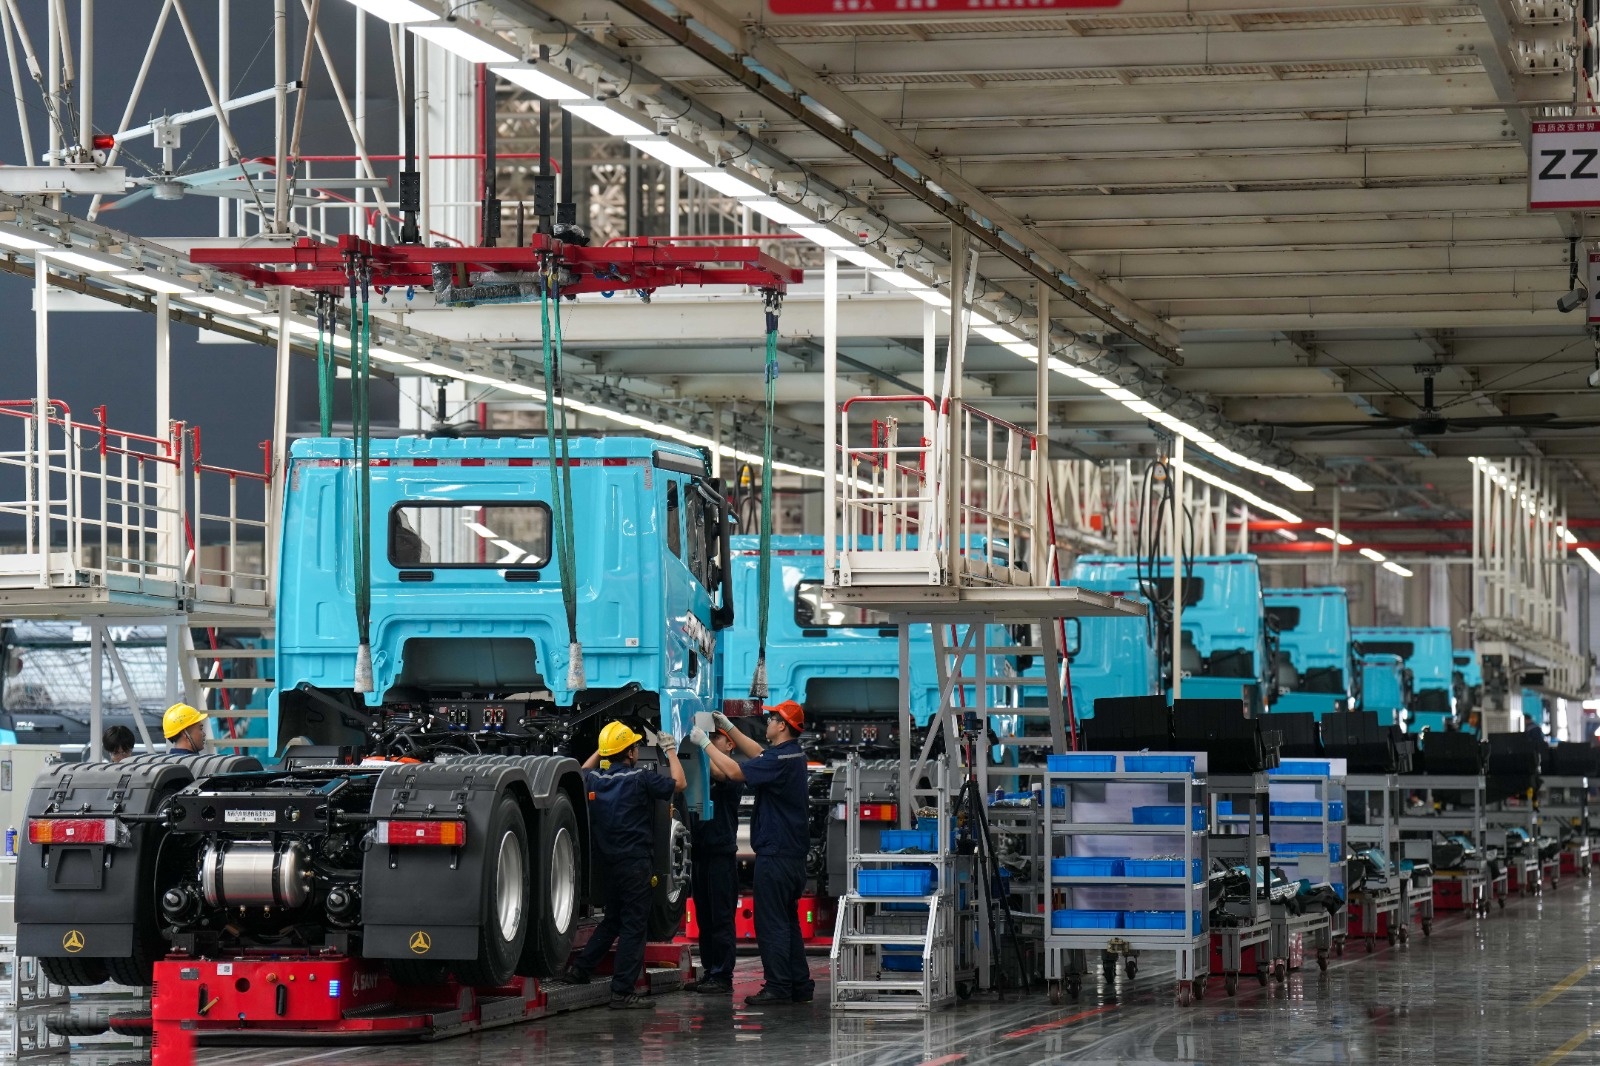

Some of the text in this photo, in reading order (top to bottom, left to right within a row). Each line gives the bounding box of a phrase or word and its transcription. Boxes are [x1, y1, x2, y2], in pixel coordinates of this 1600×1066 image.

[1537, 122, 1595, 133] 品质改变世界
[1538, 148, 1599, 180] ZZ
[360, 972, 379, 990] SANY
